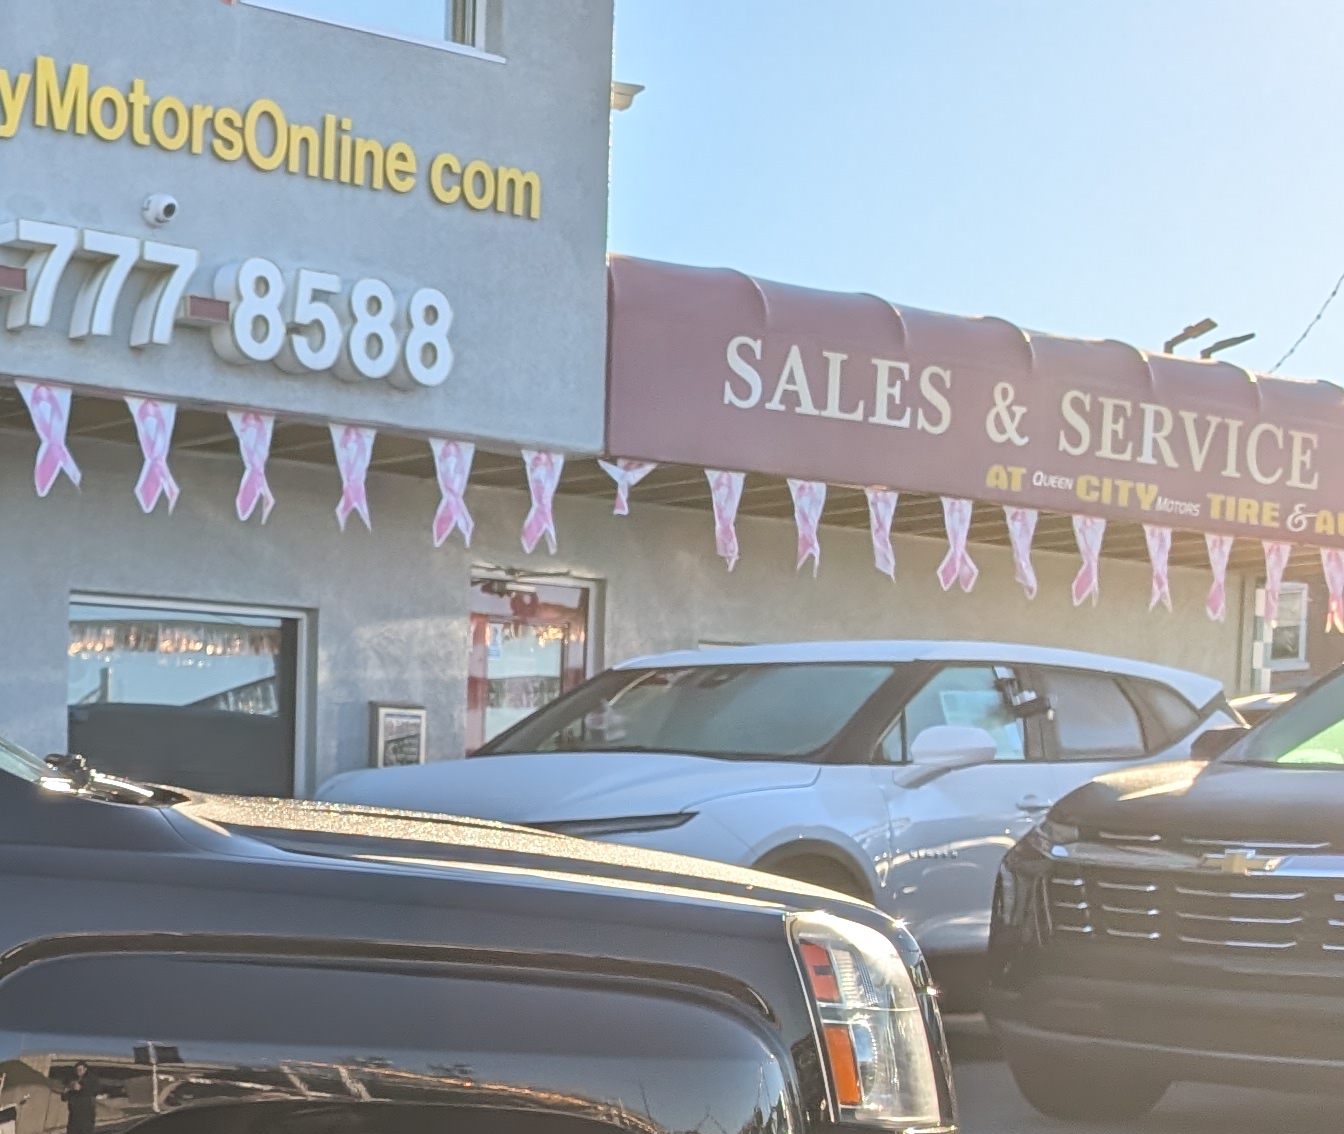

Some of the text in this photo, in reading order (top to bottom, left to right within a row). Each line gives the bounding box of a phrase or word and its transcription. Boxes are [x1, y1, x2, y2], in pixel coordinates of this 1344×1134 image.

[723, 335, 1319, 490] SALES & SERVICE
[985, 464, 1027, 492] AT
[1076, 474, 1158, 511] CITY
[1154, 496, 1201, 517] MOTORS
[1206, 492, 1281, 528] TIRE
[1286, 503, 1317, 532] &
